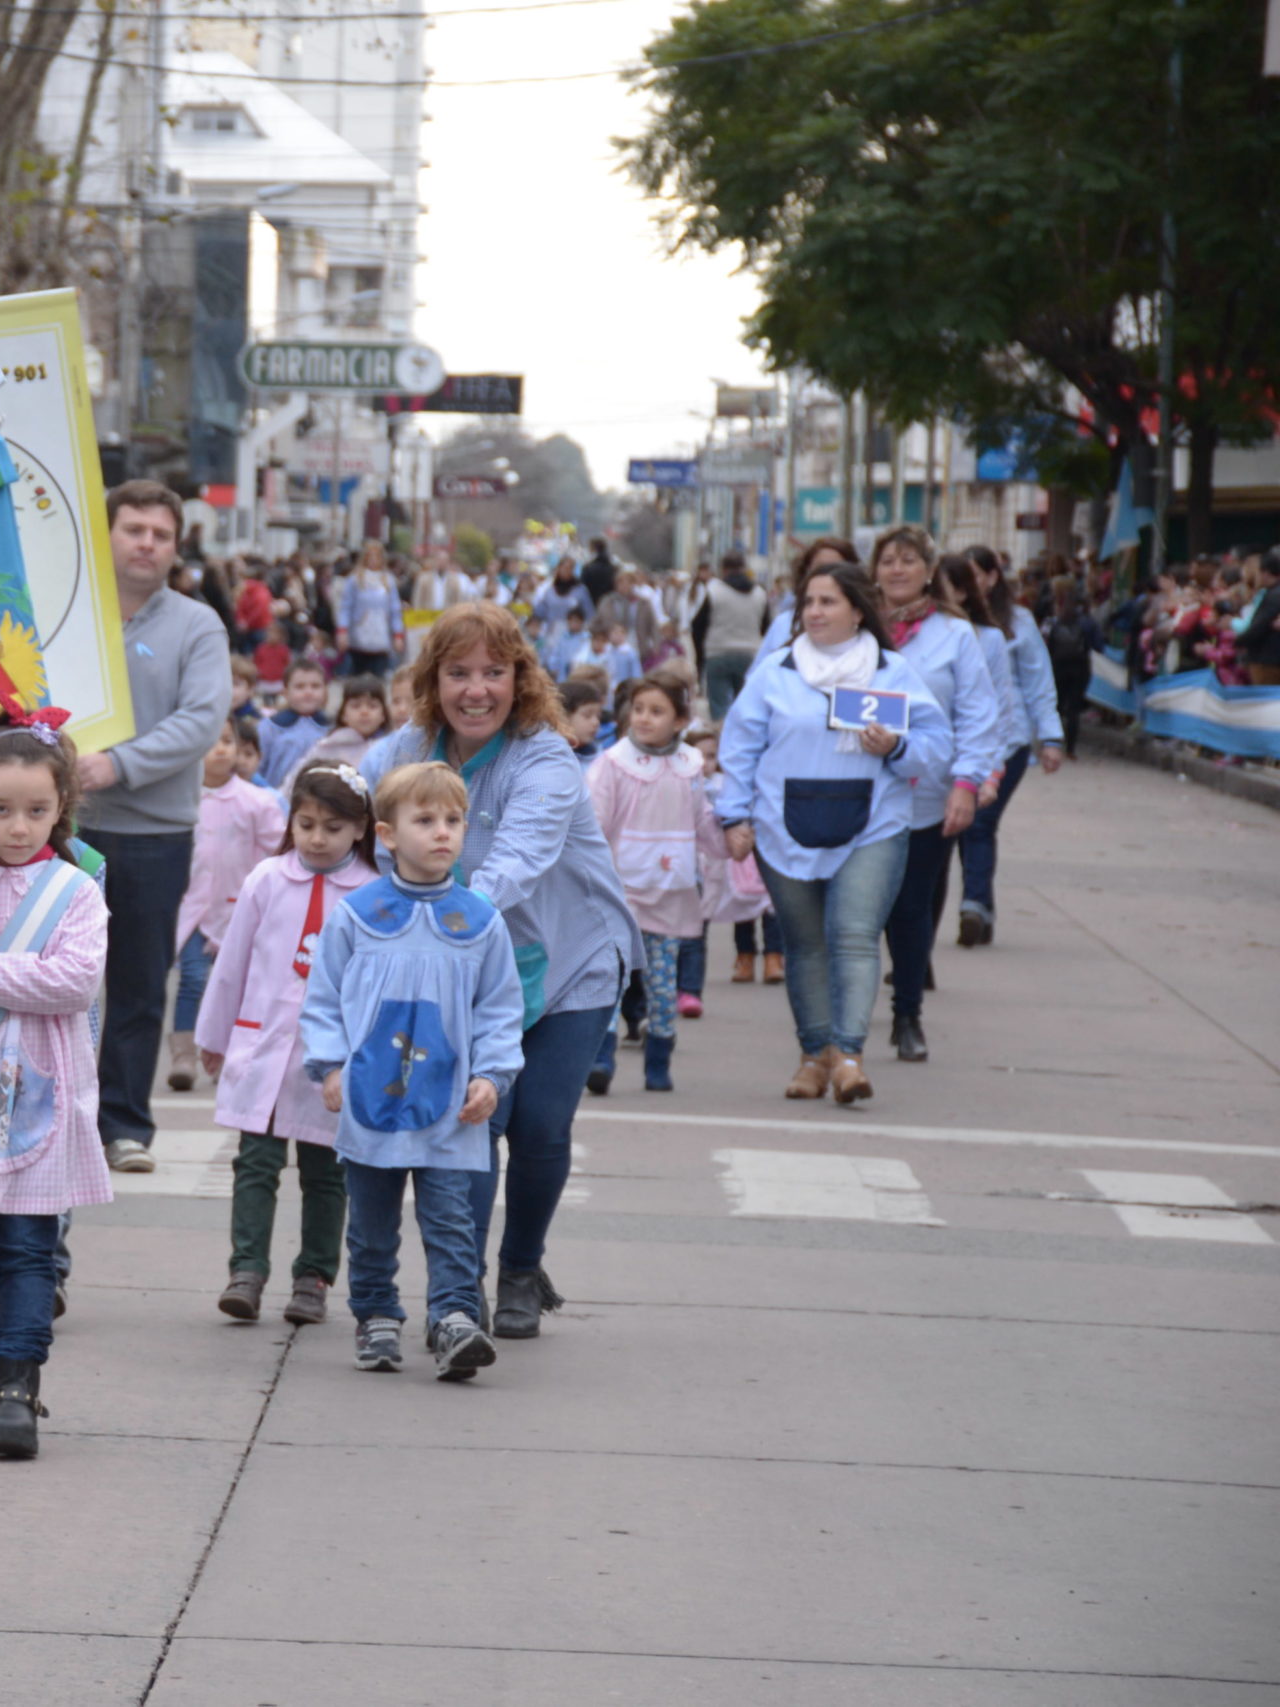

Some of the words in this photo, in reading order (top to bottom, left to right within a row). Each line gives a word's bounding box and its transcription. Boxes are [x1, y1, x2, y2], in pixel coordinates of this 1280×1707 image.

[13, 363, 47, 383] 901
[251, 345, 391, 385] FARMACIA
[860, 695, 879, 721] 2
